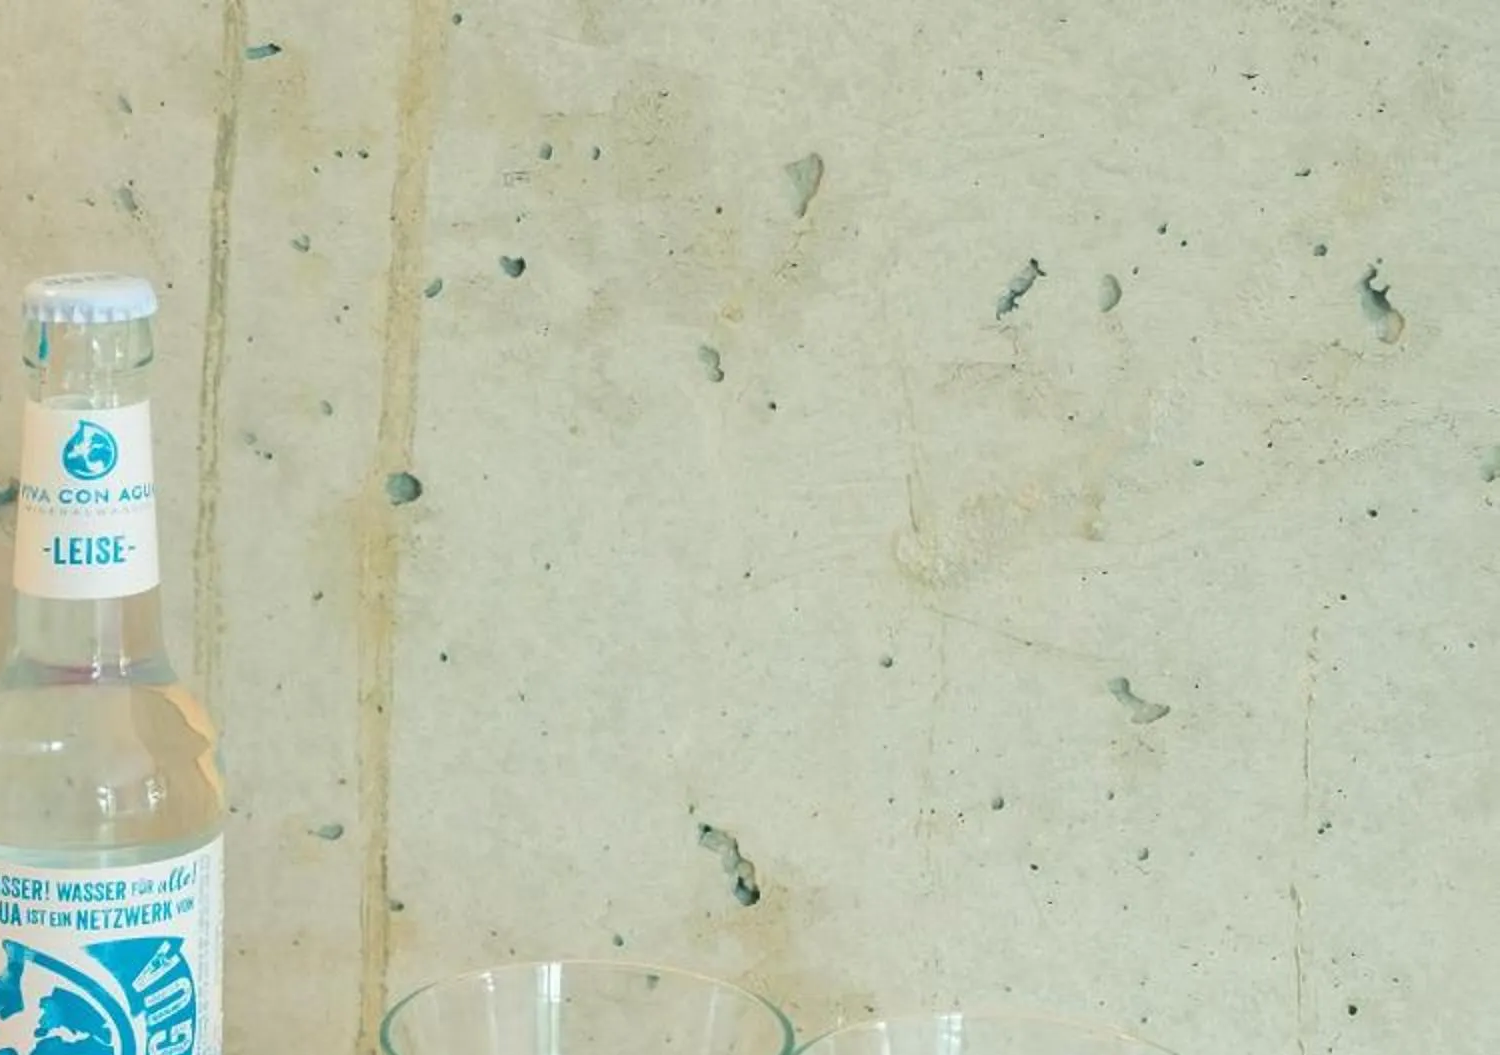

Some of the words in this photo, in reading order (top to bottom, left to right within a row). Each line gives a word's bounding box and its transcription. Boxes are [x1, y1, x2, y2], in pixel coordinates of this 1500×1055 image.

[57, 488, 110, 505] CON
[55, 880, 127, 902] WASSER
[25, 908, 47, 927] IST
[49, 910, 73, 928] EIN
[75, 899, 173, 931] NETZWERK
